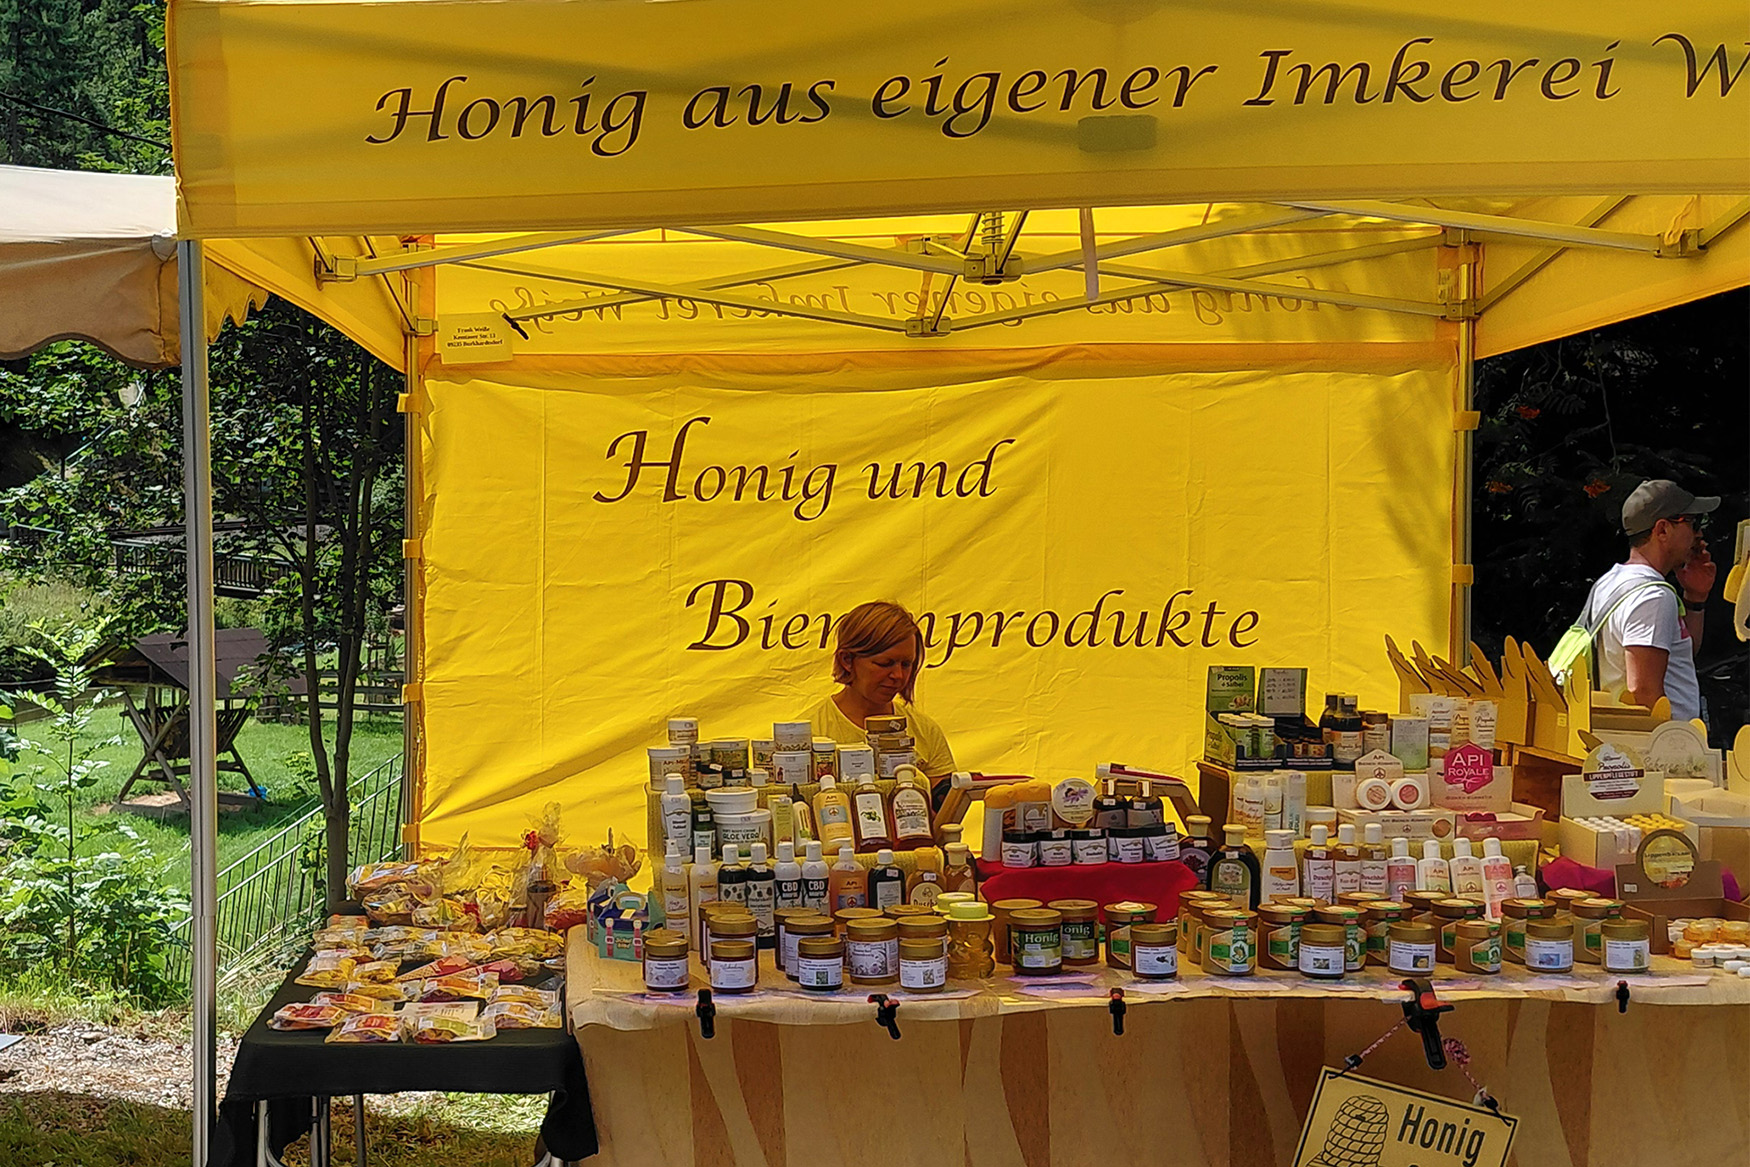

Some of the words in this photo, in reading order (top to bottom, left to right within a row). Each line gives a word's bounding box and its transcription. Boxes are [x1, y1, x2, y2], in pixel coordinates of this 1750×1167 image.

[366, 76, 647, 156] Honig
[684, 81, 835, 129] aus
[872, 57, 1218, 138] eigener
[1243, 38, 1620, 106] Imkerei
[593, 417, 837, 520] Honig
[869, 440, 1015, 499] und
[686, 579, 1259, 673] Biennprodukte
[1217, 673, 1247, 681] Propolis
[1451, 753, 1484, 766] API
[1448, 767, 1490, 778] ROYALE
[722, 832, 739, 840] ALOE
[781, 882, 799, 892] CBD
[808, 880, 825, 891] CBD
[1064, 924, 1091, 935] onig
[1025, 931, 1059, 944] Honig
[1397, 1103, 1487, 1167] Honig
